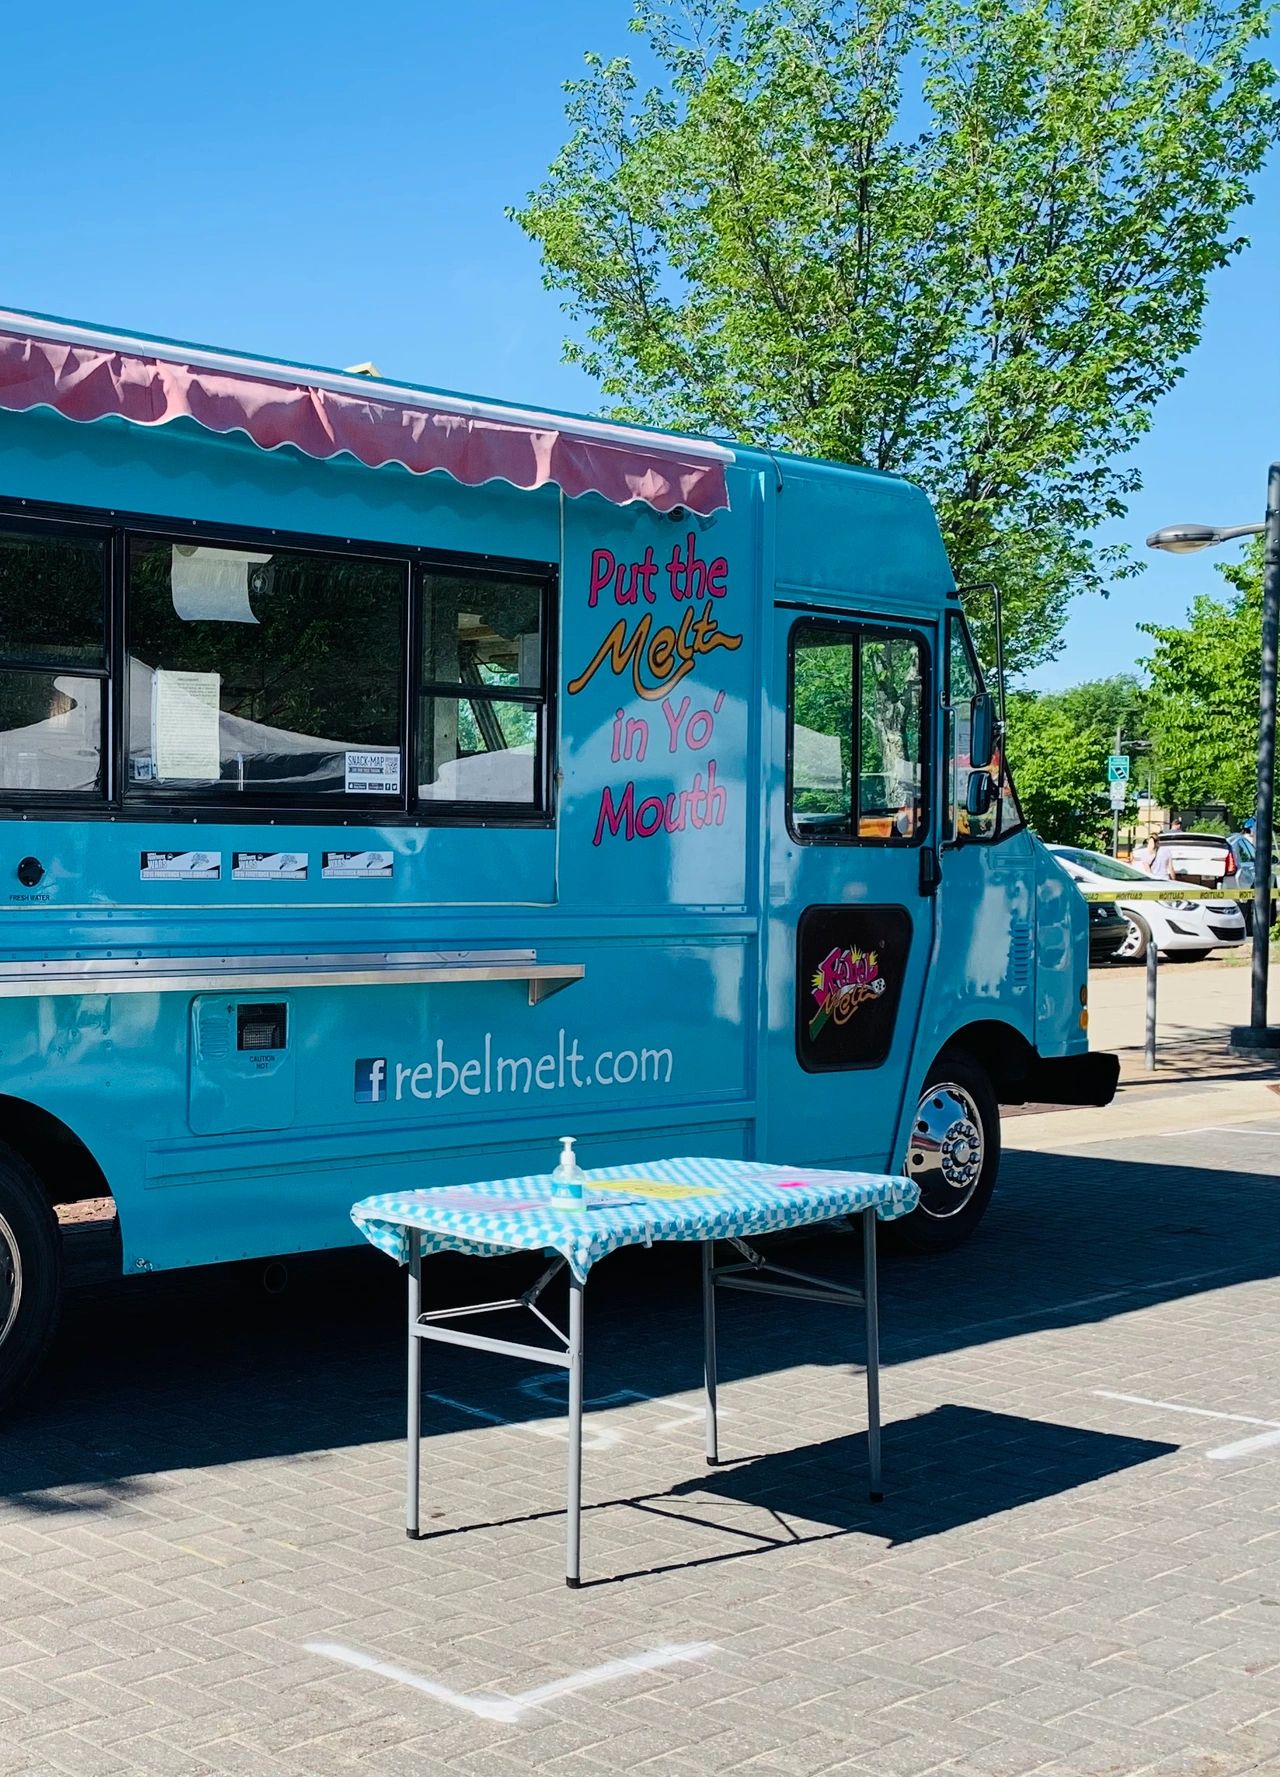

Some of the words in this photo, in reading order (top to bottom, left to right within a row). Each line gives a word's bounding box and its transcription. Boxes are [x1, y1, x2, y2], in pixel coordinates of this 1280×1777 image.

[587, 545, 658, 607] Put
[667, 532, 728, 601] the
[568, 599, 743, 701] Melt
[611, 707, 648, 763] in
[662, 690, 726, 753] Yo'
[592, 759, 727, 847] Mouth
[249, 1055, 276, 1063] CAUTION
[395, 1028, 674, 1100] rebelmelt.com
